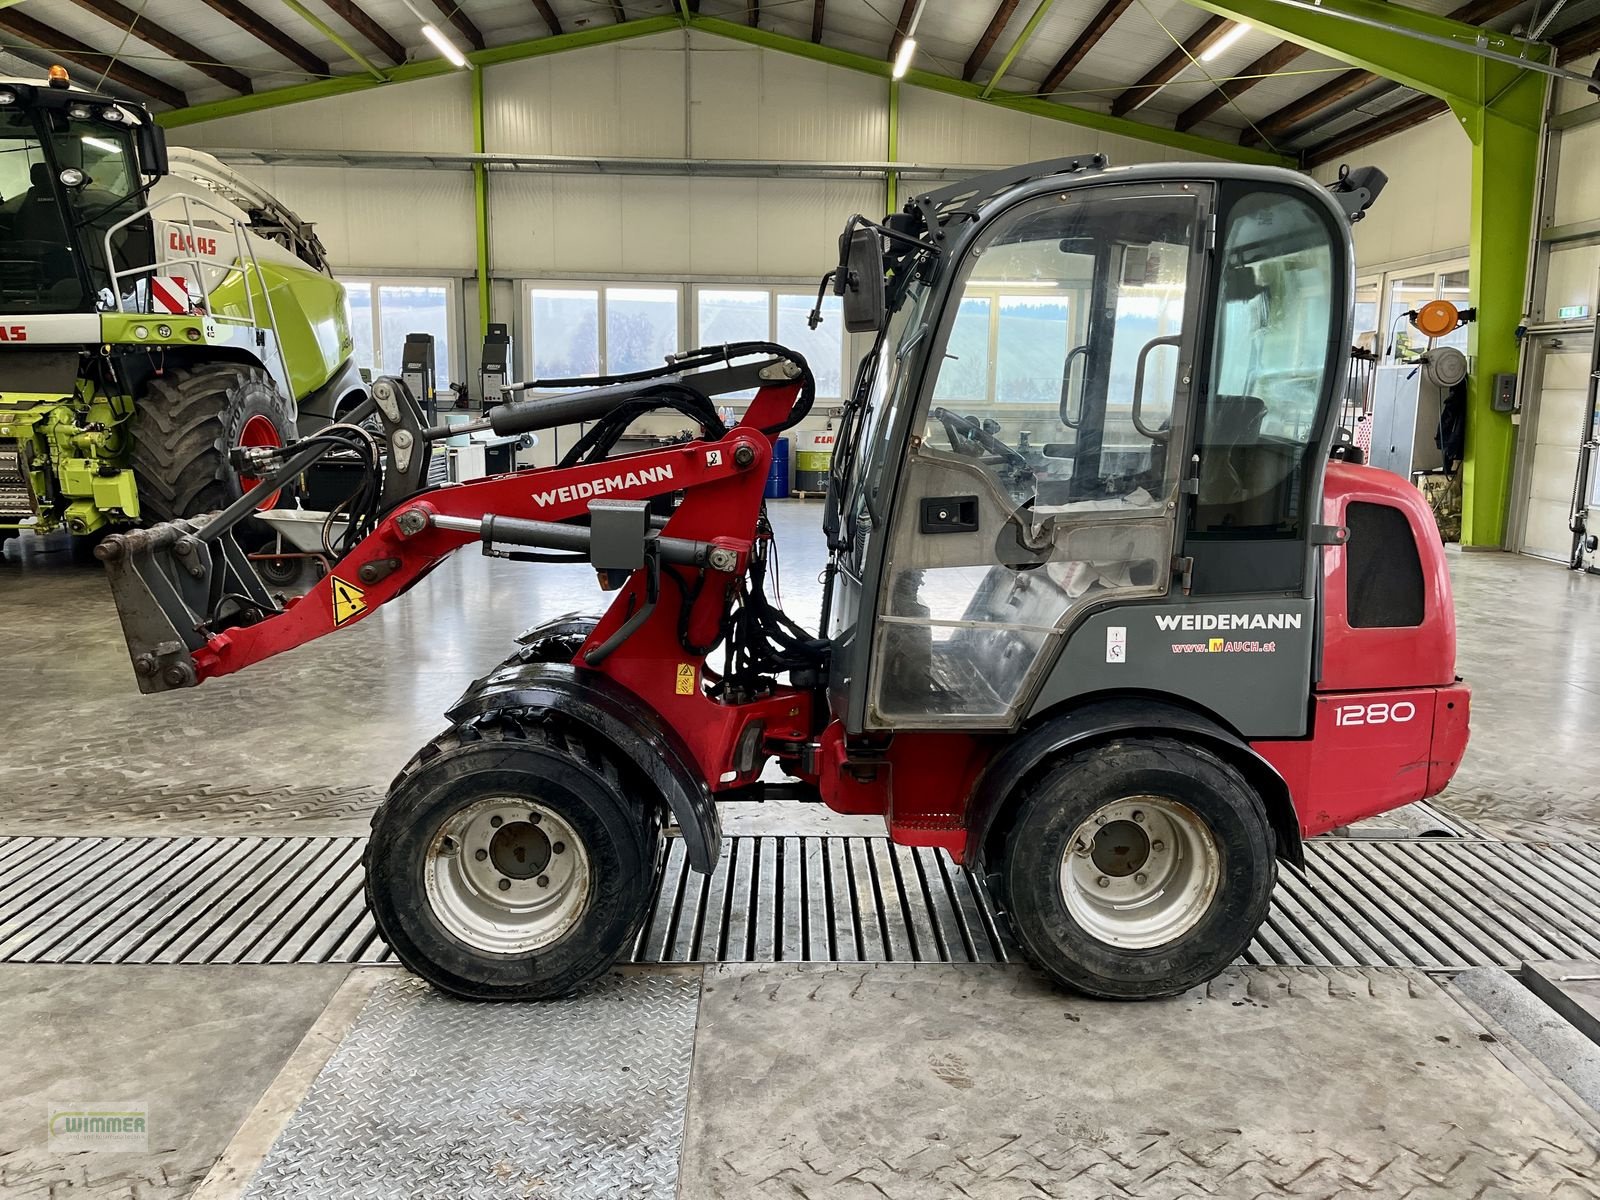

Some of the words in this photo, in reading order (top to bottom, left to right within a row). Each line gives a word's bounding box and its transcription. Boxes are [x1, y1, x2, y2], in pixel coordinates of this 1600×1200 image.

[814, 436, 835, 444] CLA
[531, 464, 674, 508] WEIDEMANN
[1155, 613, 1302, 631] WEIDEMANN
[1171, 639, 1276, 654] www.MAUCH.at
[1334, 702, 1416, 726] 1280
